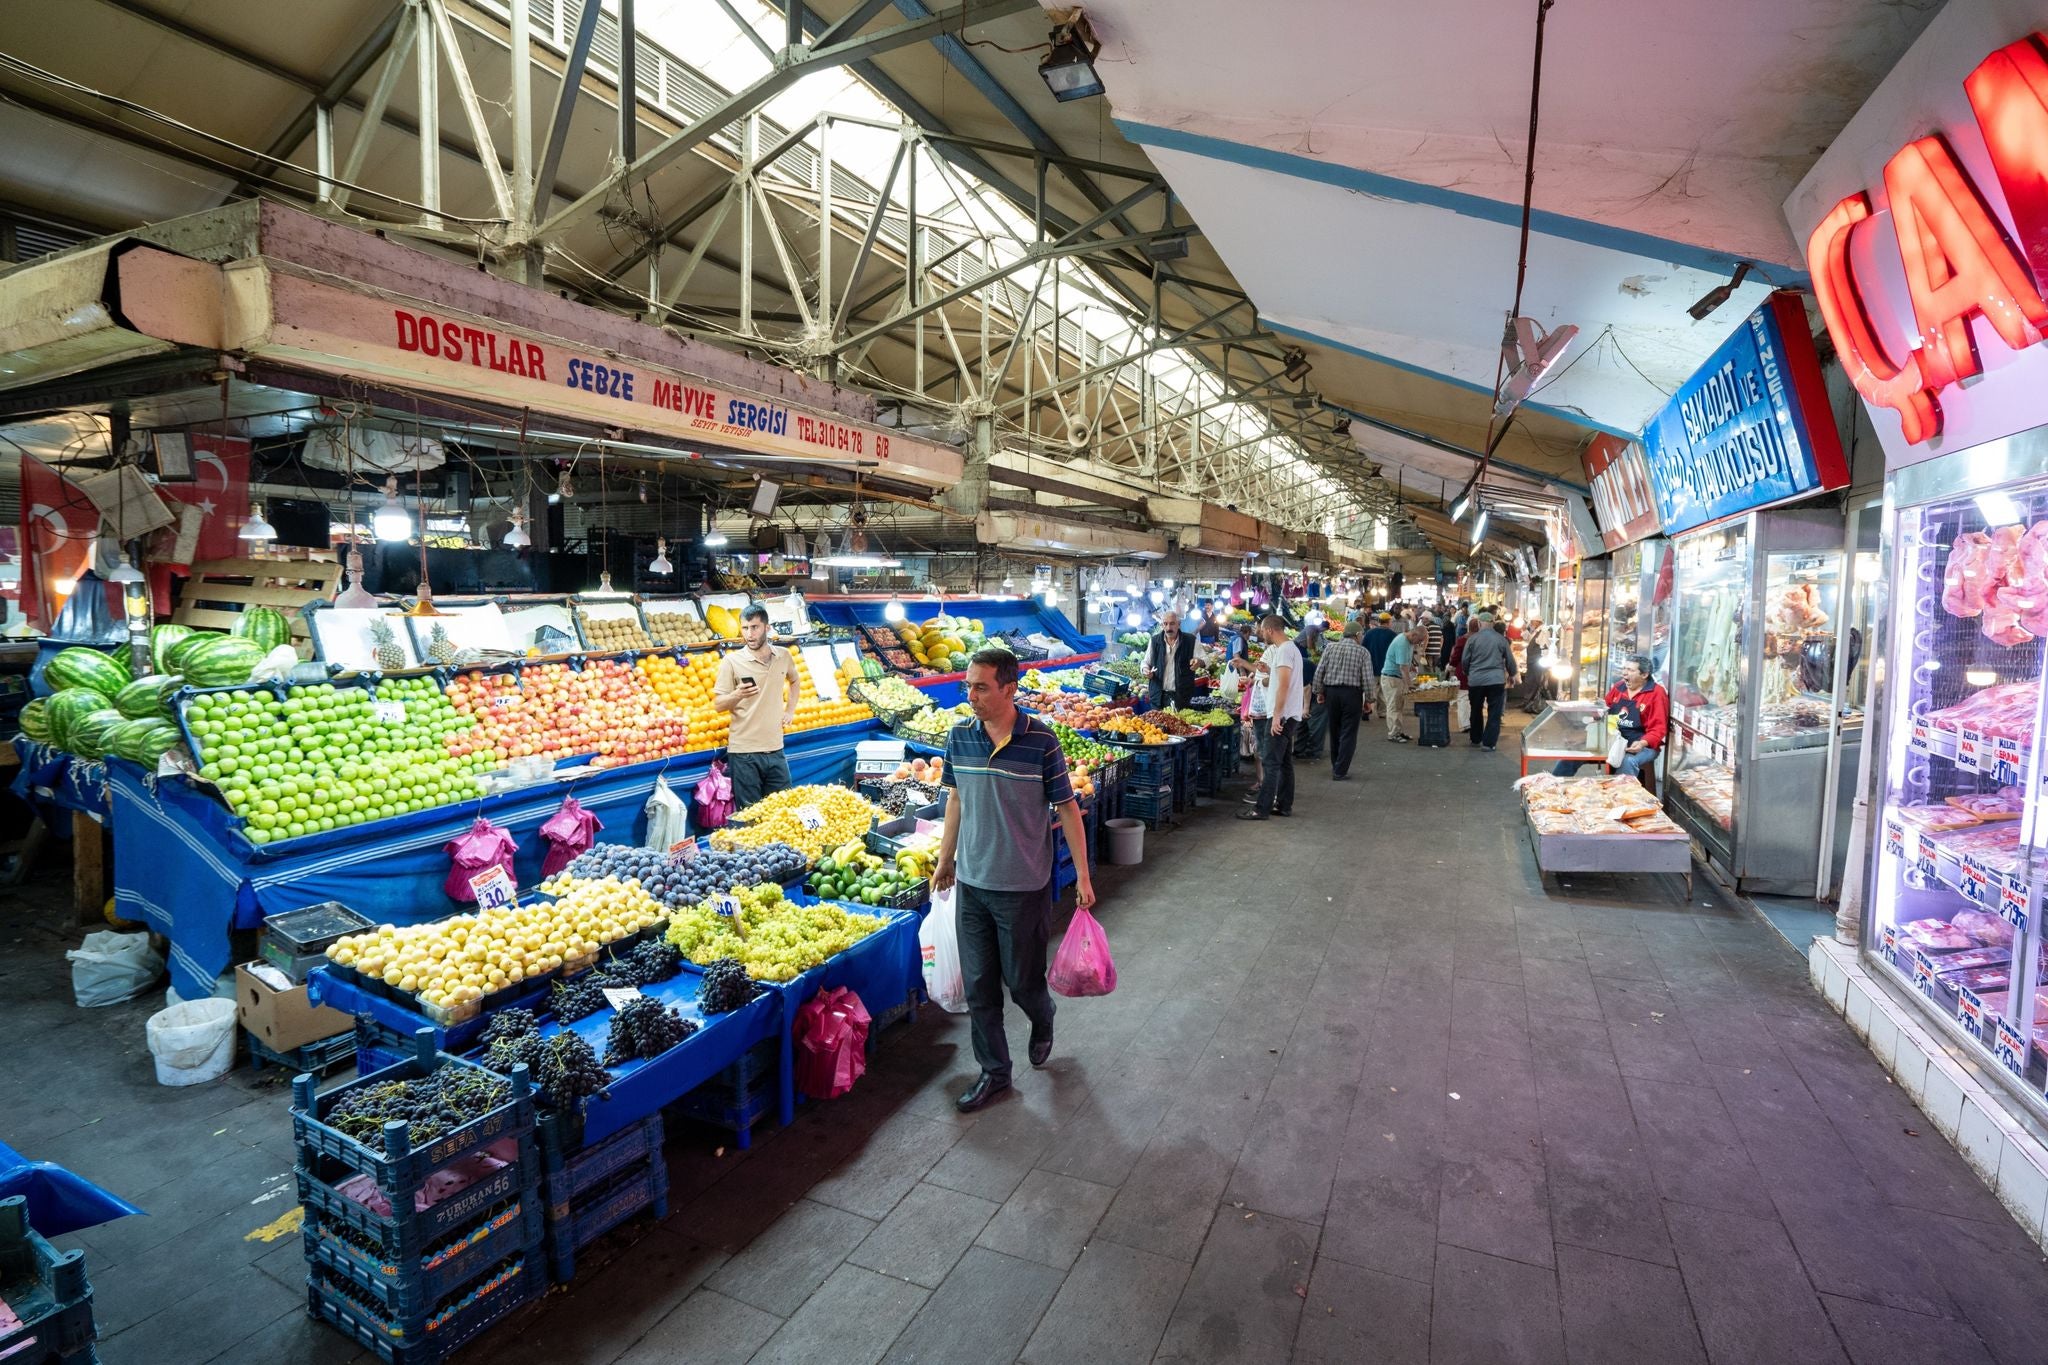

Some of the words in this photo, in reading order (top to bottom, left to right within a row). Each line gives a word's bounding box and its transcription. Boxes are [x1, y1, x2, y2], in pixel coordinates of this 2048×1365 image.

[395, 310, 547, 381] DOSTLAR
[567, 358, 634, 402] SEBZE
[652, 379, 716, 420] MEYVE
[727, 400, 788, 436] SERGİSİ
[797, 416, 817, 443] TEL
[819, 422, 835, 448] 310
[838, 427, 849, 451] 64
[851, 431, 863, 454] 78
[876, 435, 889, 459] 6/B
[1681, 360, 1743, 446] SAKADAT
[1739, 371, 1762, 408] VE
[485, 887, 505, 910] 30
[431, 1128, 478, 1164] SEFA
[483, 1116, 504, 1136] 47
[493, 1176, 509, 1195] 56
